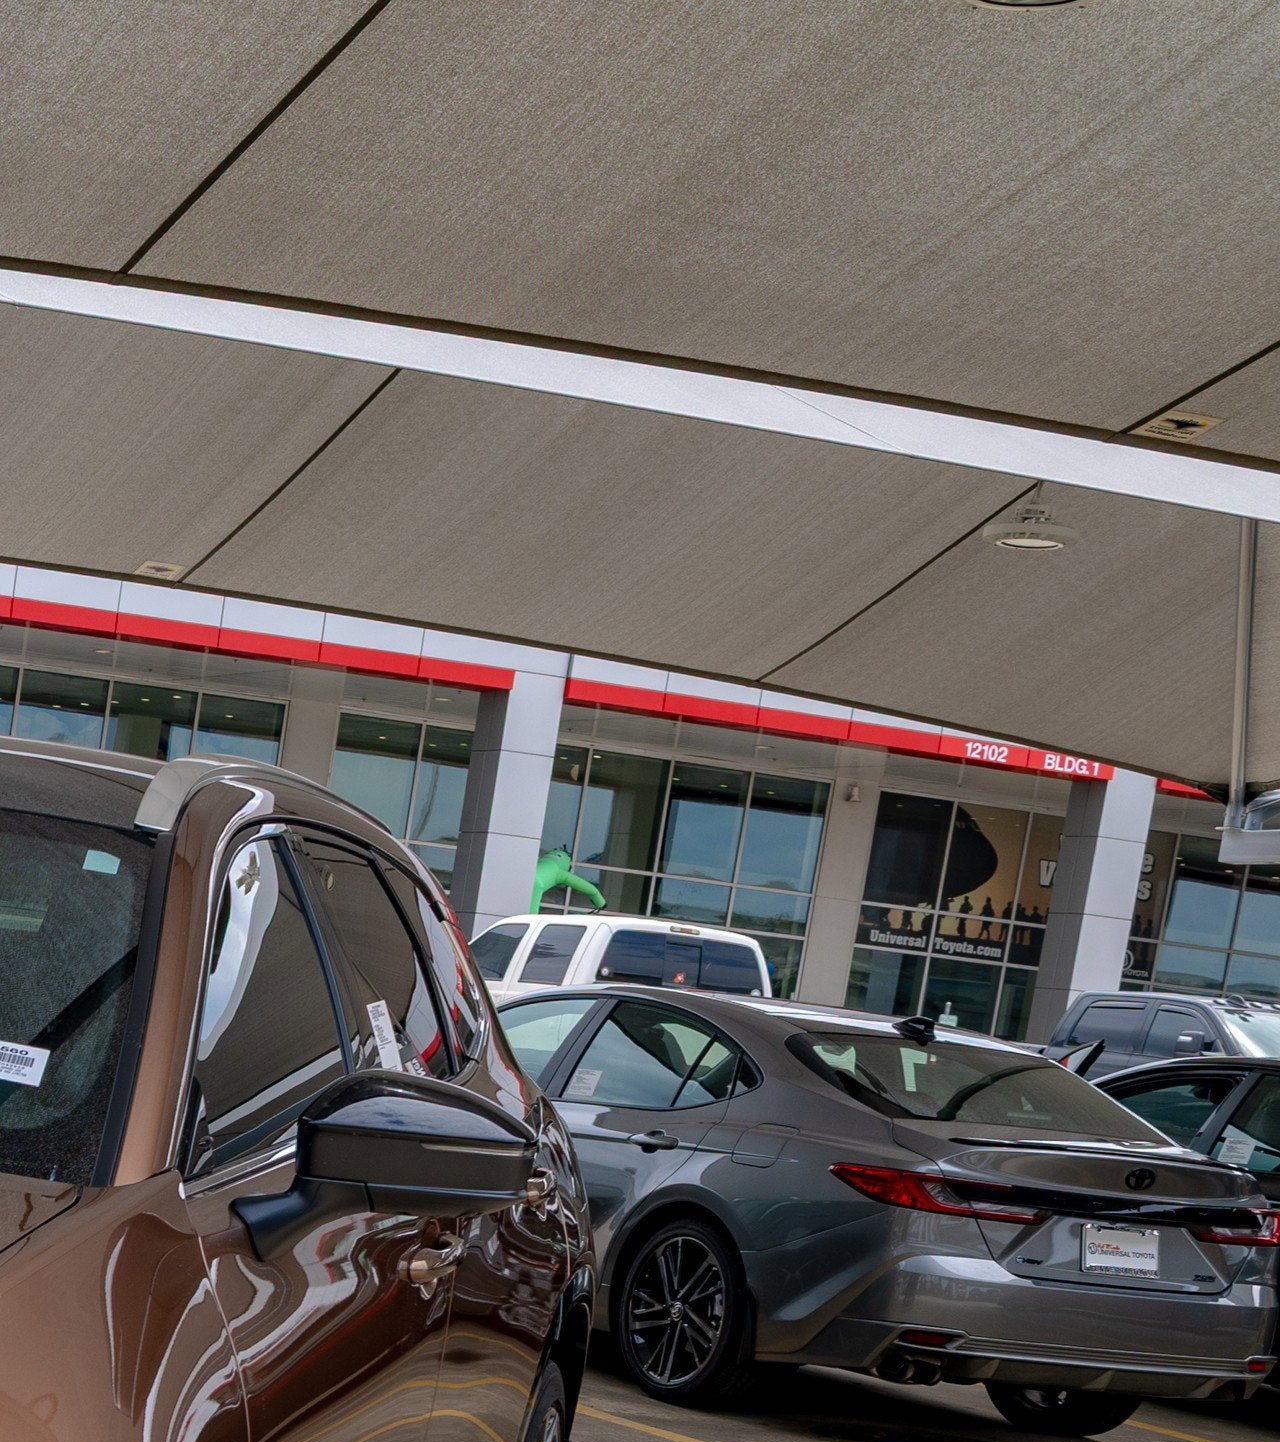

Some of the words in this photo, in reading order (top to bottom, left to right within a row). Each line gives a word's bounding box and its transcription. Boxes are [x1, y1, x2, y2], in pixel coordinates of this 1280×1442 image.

[965, 741, 1008, 763] 12102
[1044, 753, 1089, 775] BLDG.
[1092, 762, 1100, 776] 1
[870, 929, 926, 948] Universal
[934, 937, 1002, 958] Toyota.com
[1097, 1249, 1131, 1257] UNIVERSAL
[1132, 1251, 1156, 1259] TOYOTA
